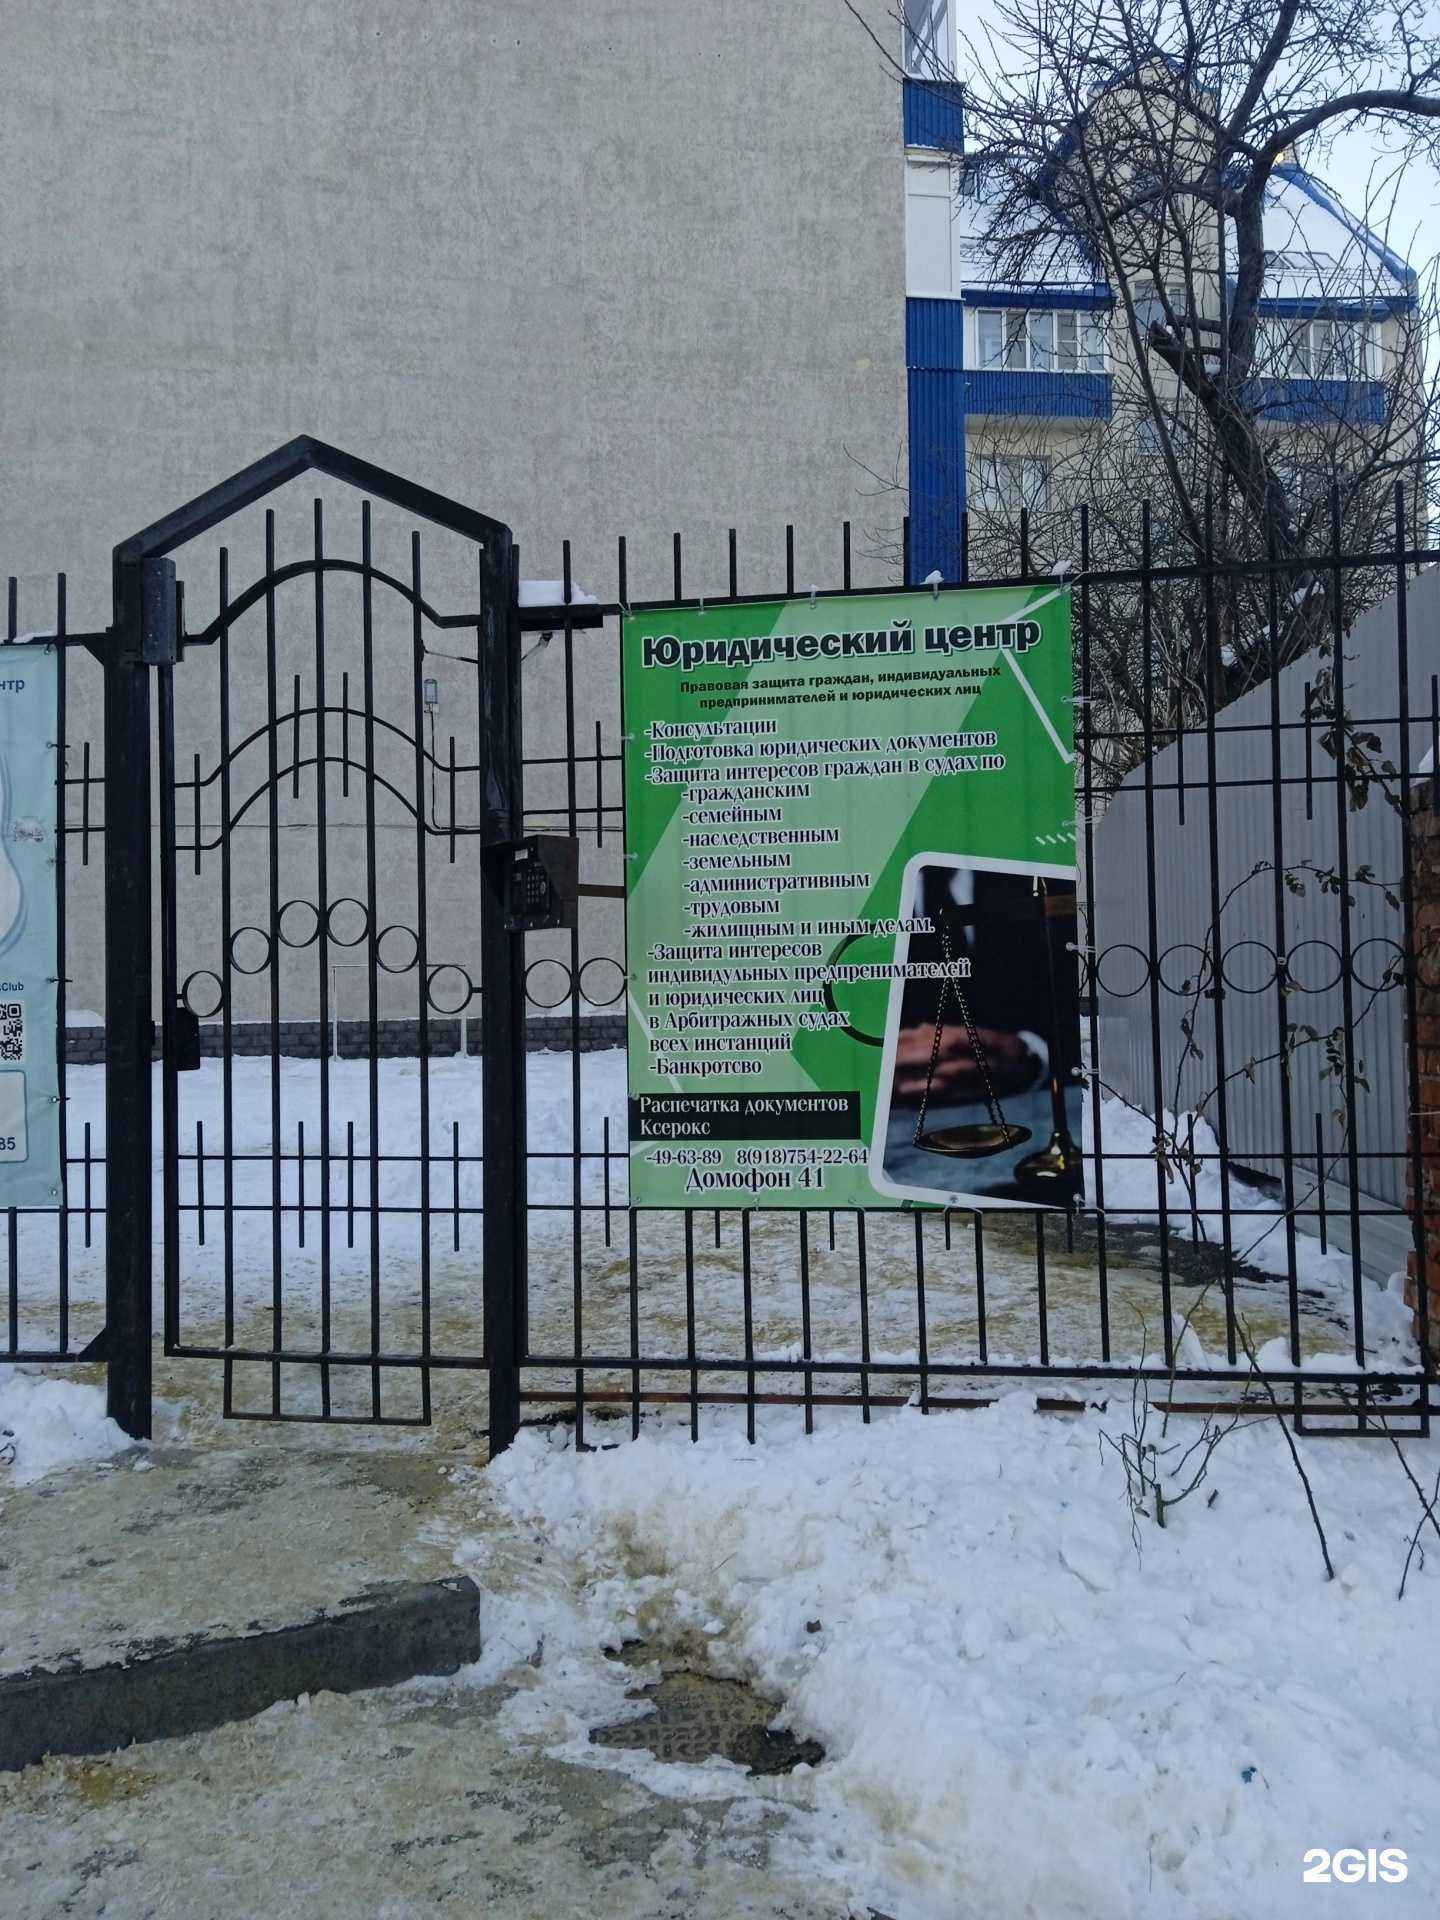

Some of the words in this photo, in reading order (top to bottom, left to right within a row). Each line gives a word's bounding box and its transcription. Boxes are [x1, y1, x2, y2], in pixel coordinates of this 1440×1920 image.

[643, 618, 914, 671] Юридический
[924, 620, 1042, 656] центр
[680, 680, 749, 695] Правовая
[751, 677, 805, 690] защита
[808, 672, 874, 690] граждан,
[877, 666, 1001, 684] индивидуальных
[699, 689, 835, 710] предпринимателей
[839, 691, 849, 702] и
[852, 685, 952, 703] юридических
[954, 682, 982, 697] лиц
[645, 719, 777, 741] -Консультации
[645, 744, 754, 764] -Подготовка
[759, 738, 881, 760] юридических
[886, 731, 997, 752] документов
[645, 767, 721, 785] -Защита
[726, 761, 819, 783] интересов
[824, 758, 901, 780] граждан
[908, 757, 920, 773] в
[924, 754, 977, 776] судах
[981, 754, 1005, 770] по
[681, 782, 811, 804] -гражданским
[682, 805, 783, 825] -семейным
[682, 828, 841, 850] -наследственным
[683, 852, 792, 871] -земельным
[683, 873, 870, 896] -административным
[684, 899, 781, 919] -трудовым
[684, 921, 796, 940] -жилищным
[800, 922, 812, 936] и
[817, 920, 870, 936] иным
[873, 916, 935, 938] делам.
[648, 943, 723, 963] -Защита
[728, 943, 823, 961] интересов
[648, 966, 790, 986] индивидульных
[794, 957, 971, 984] предпренимателей
[649, 993, 660, 1007] и
[665, 990, 785, 1009] юридических
[791, 988, 827, 1006] лиц
[649, 1015, 660, 1030] в
[664, 1012, 793, 1032] Арбитражных
[798, 1010, 850, 1030] судах
[649, 1036, 690, 1052] всех
[694, 1032, 793, 1052] инстанций
[649, 1058, 763, 1077] -Банкротсво
[639, 1096, 740, 1114] Распечатка
[744, 1096, 850, 1116] документов
[640, 1118, 711, 1138] Ксерокс
[645, 1148, 723, 1165] -49-63-89
[736, 1147, 869, 1166] 8(918)754-22-64
[686, 1167, 791, 1192] Домофон
[797, 1166, 825, 1189] 41
